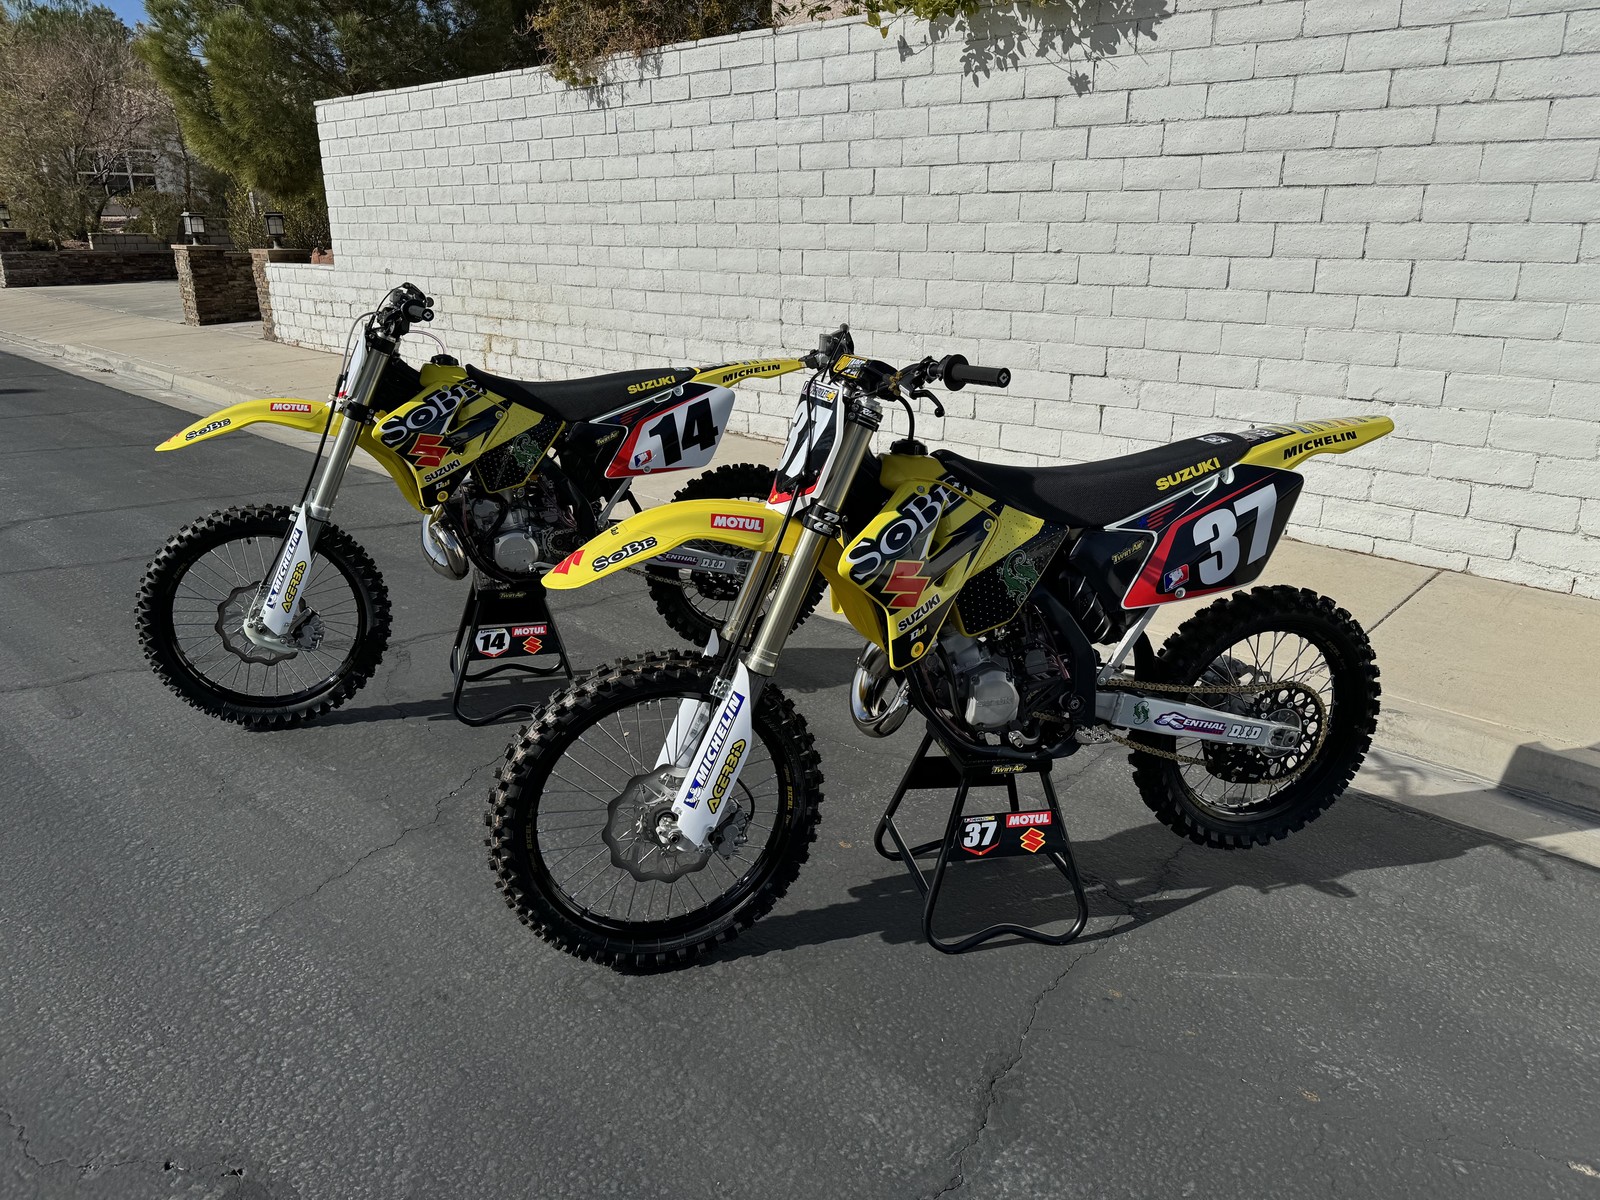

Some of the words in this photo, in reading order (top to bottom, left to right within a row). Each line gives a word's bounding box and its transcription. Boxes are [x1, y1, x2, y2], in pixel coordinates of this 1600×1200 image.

[722, 364, 780, 383] MICHELIN
[627, 375, 676, 394] SUZUKI
[271, 403, 310, 412] MOTUL
[649, 397, 719, 467] 14
[1283, 431, 1357, 460] MICHELIN
[424, 459, 461, 483] SUZUKI
[1155, 457, 1220, 491] SUZUKI
[713, 515, 762, 531] MOTUL
[1192, 483, 1278, 585] 37
[273, 528, 303, 593] MICHELIN
[1112, 547, 1132, 563] Twin
[898, 593, 941, 632] SUZUKI
[480, 632, 506, 651] 14
[514, 626, 546, 636] MOTUL
[695, 691, 743, 787] MICHELIN
[993, 766, 1012, 774] Twin
[1008, 813, 1050, 826] MOTUL
[963, 821, 998, 847] 37
